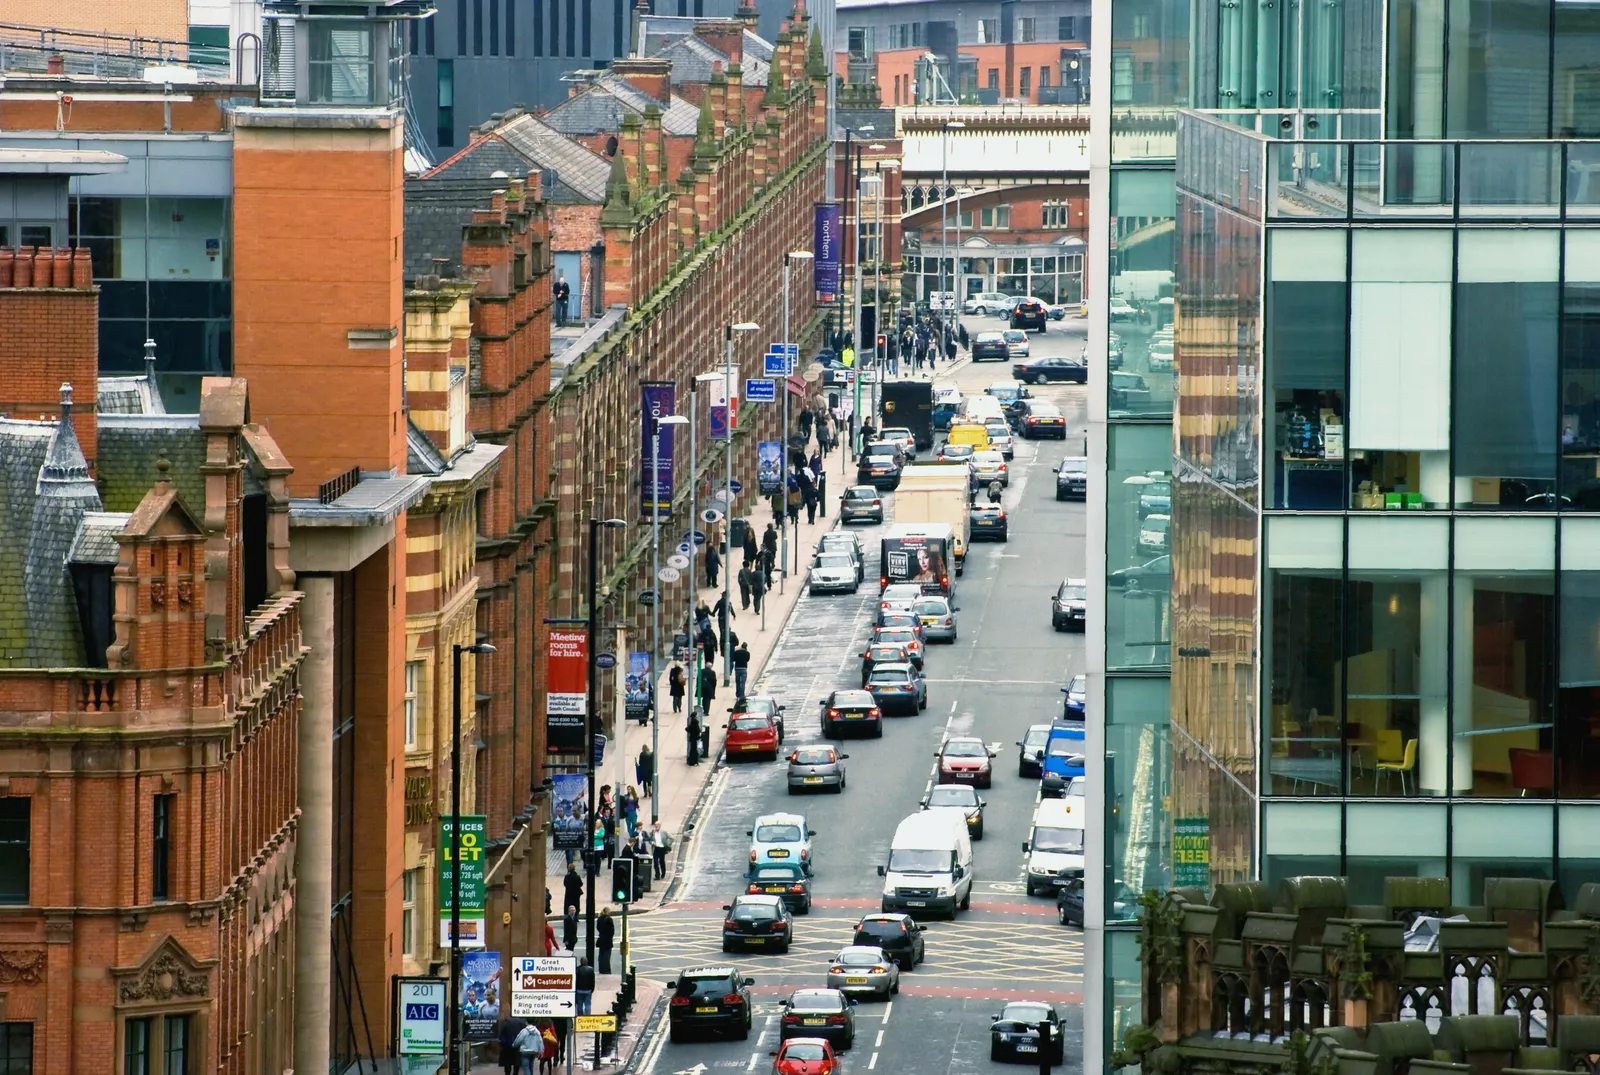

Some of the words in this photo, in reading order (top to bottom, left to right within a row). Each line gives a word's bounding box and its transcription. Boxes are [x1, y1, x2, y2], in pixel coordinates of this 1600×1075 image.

[822, 220, 830, 259] northern
[550, 633, 585, 642] Meeting
[444, 848, 482, 860] LET
[472, 872, 483, 880] sqft
[413, 985, 433, 996] 201
[408, 1005, 437, 1019] AIG
